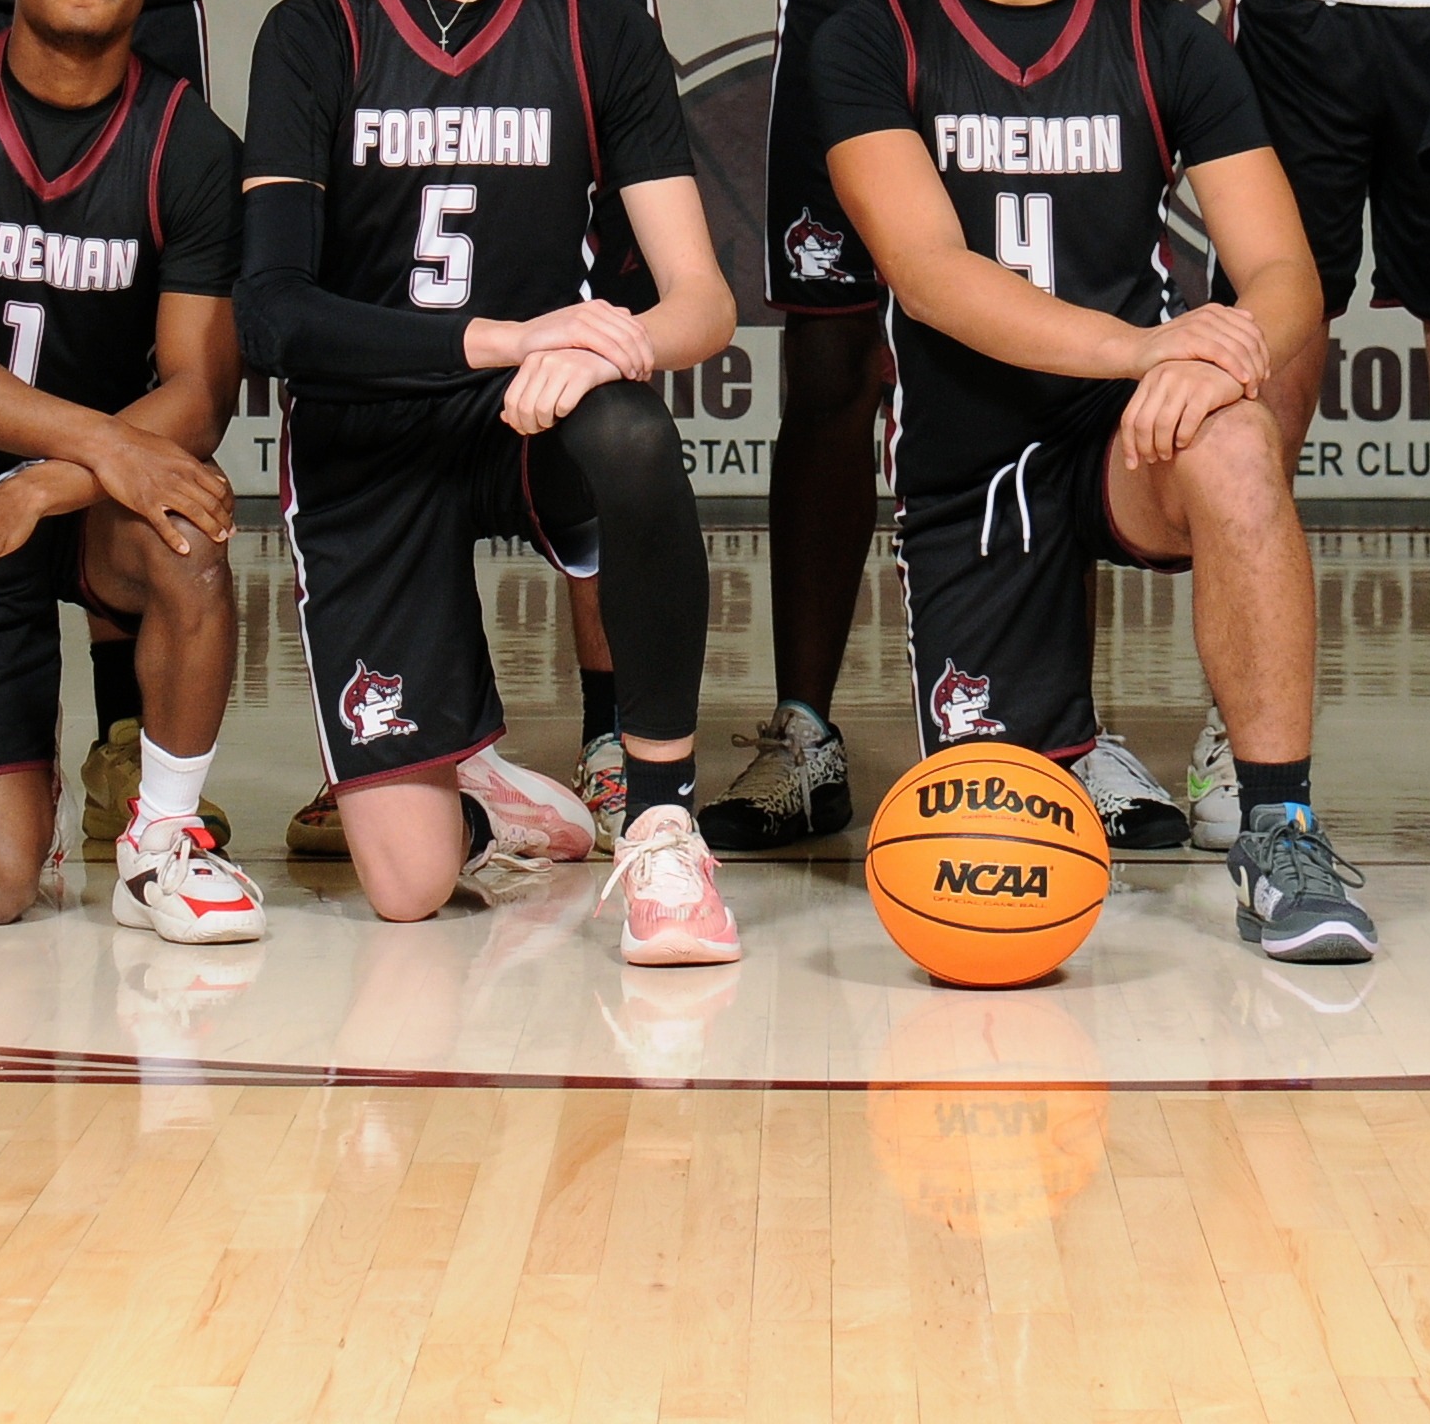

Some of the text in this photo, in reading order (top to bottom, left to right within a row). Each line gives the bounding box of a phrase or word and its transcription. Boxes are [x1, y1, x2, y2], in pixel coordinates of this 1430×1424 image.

[352, 107, 552, 167] FOREMAN
[934, 113, 1122, 174] FOREMAN
[409, 184, 477, 309] 5
[996, 191, 1055, 297] 4
[3, 299, 45, 388] 1
[681, 439, 779, 474] STAT
[916, 776, 1076, 835] Wilson
[933, 859, 1048, 898] NCAA
